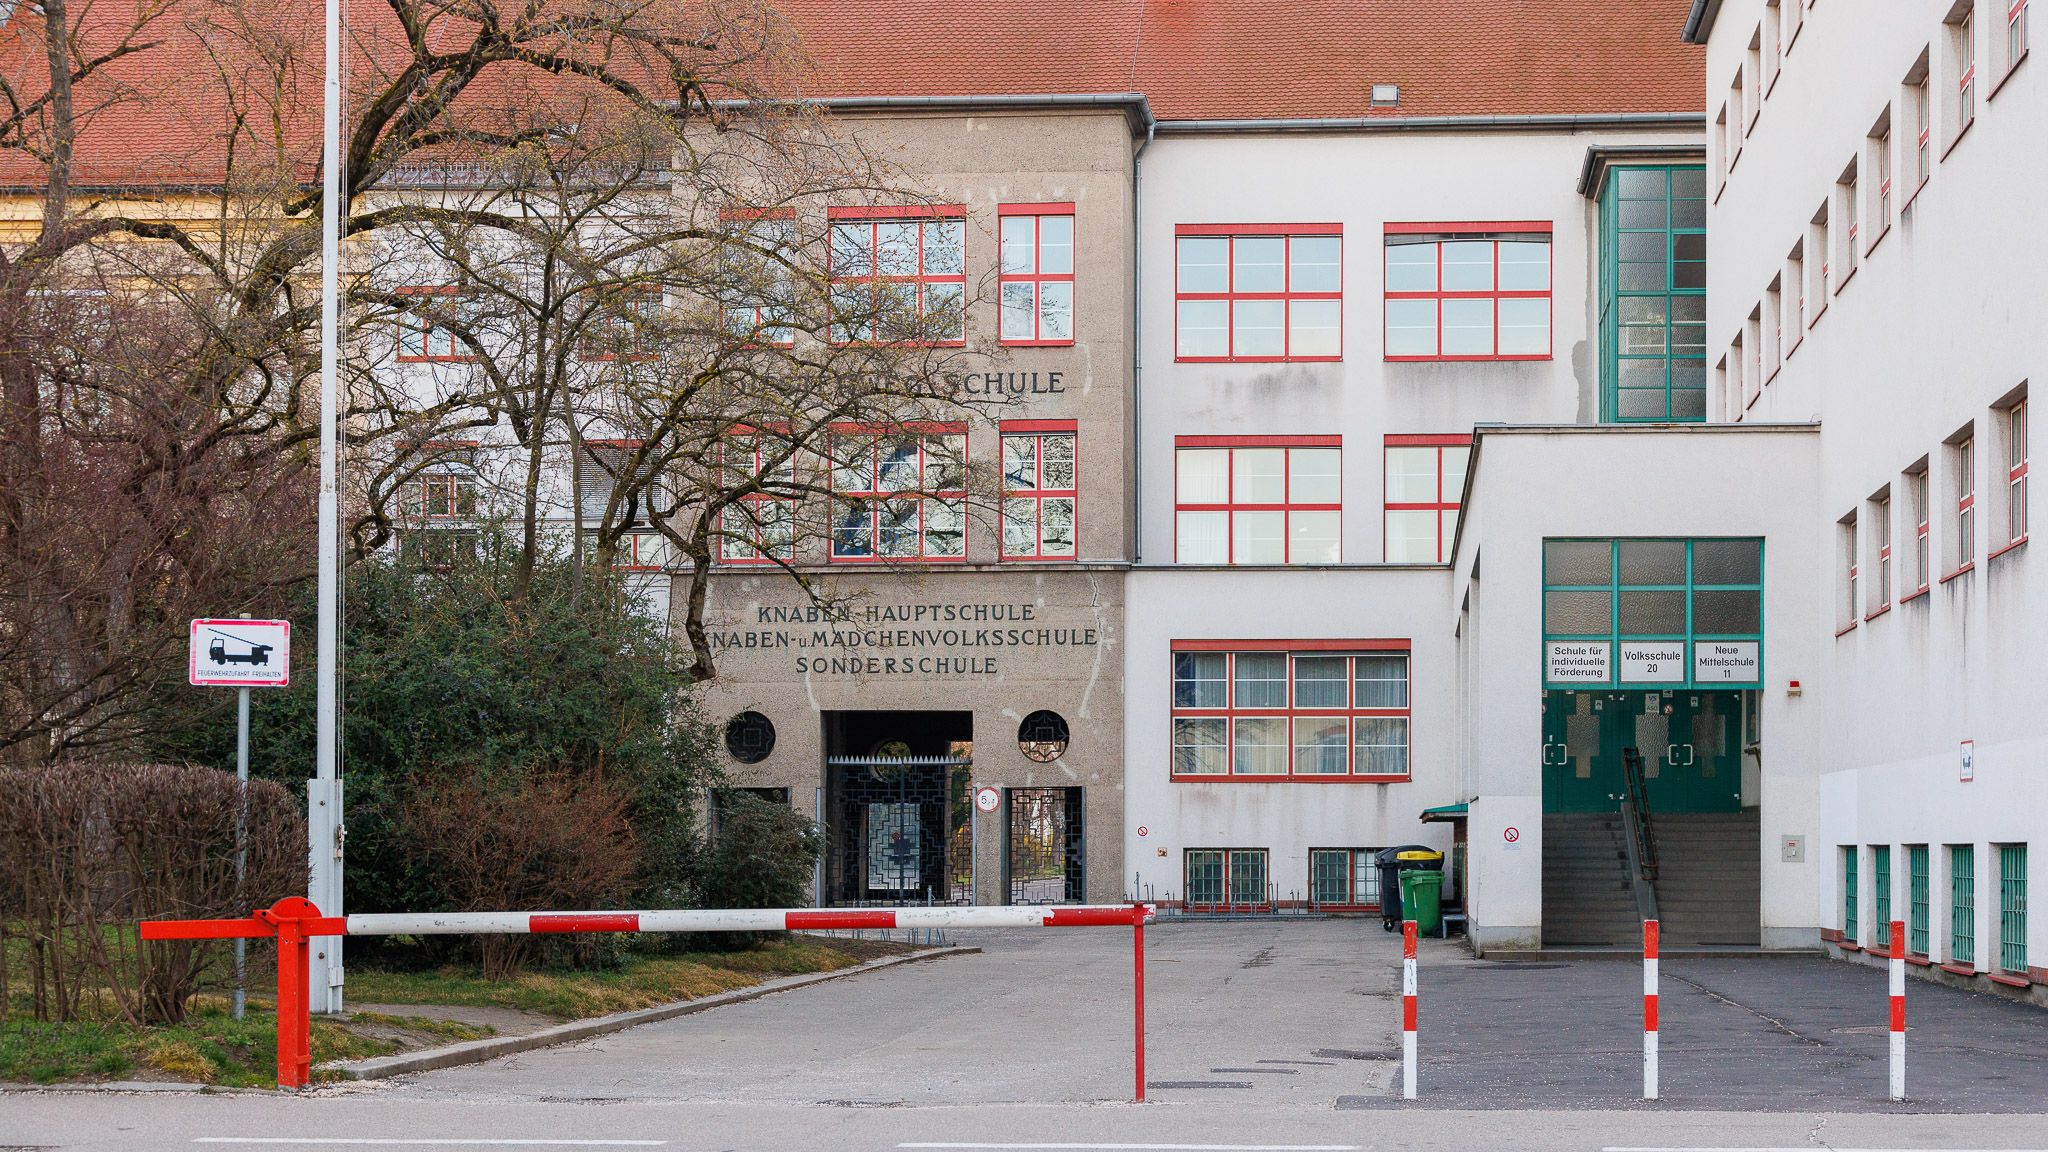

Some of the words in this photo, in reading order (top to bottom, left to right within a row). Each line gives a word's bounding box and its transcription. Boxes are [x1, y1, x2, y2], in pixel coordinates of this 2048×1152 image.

[1554, 647, 1586, 655] Schule
[1589, 647, 1602, 655] für
[1715, 646, 1738, 654] Neue
[1625, 651, 1681, 661] Volksschule
[796, 656, 998, 674] SONDERSCHULE
[1551, 657, 1605, 666] individuelle
[1700, 657, 1754, 667] Mittelschule
[1554, 667, 1603, 678] Förderung
[1647, 664, 1658, 673] 20
[1723, 669, 1731, 678] 11
